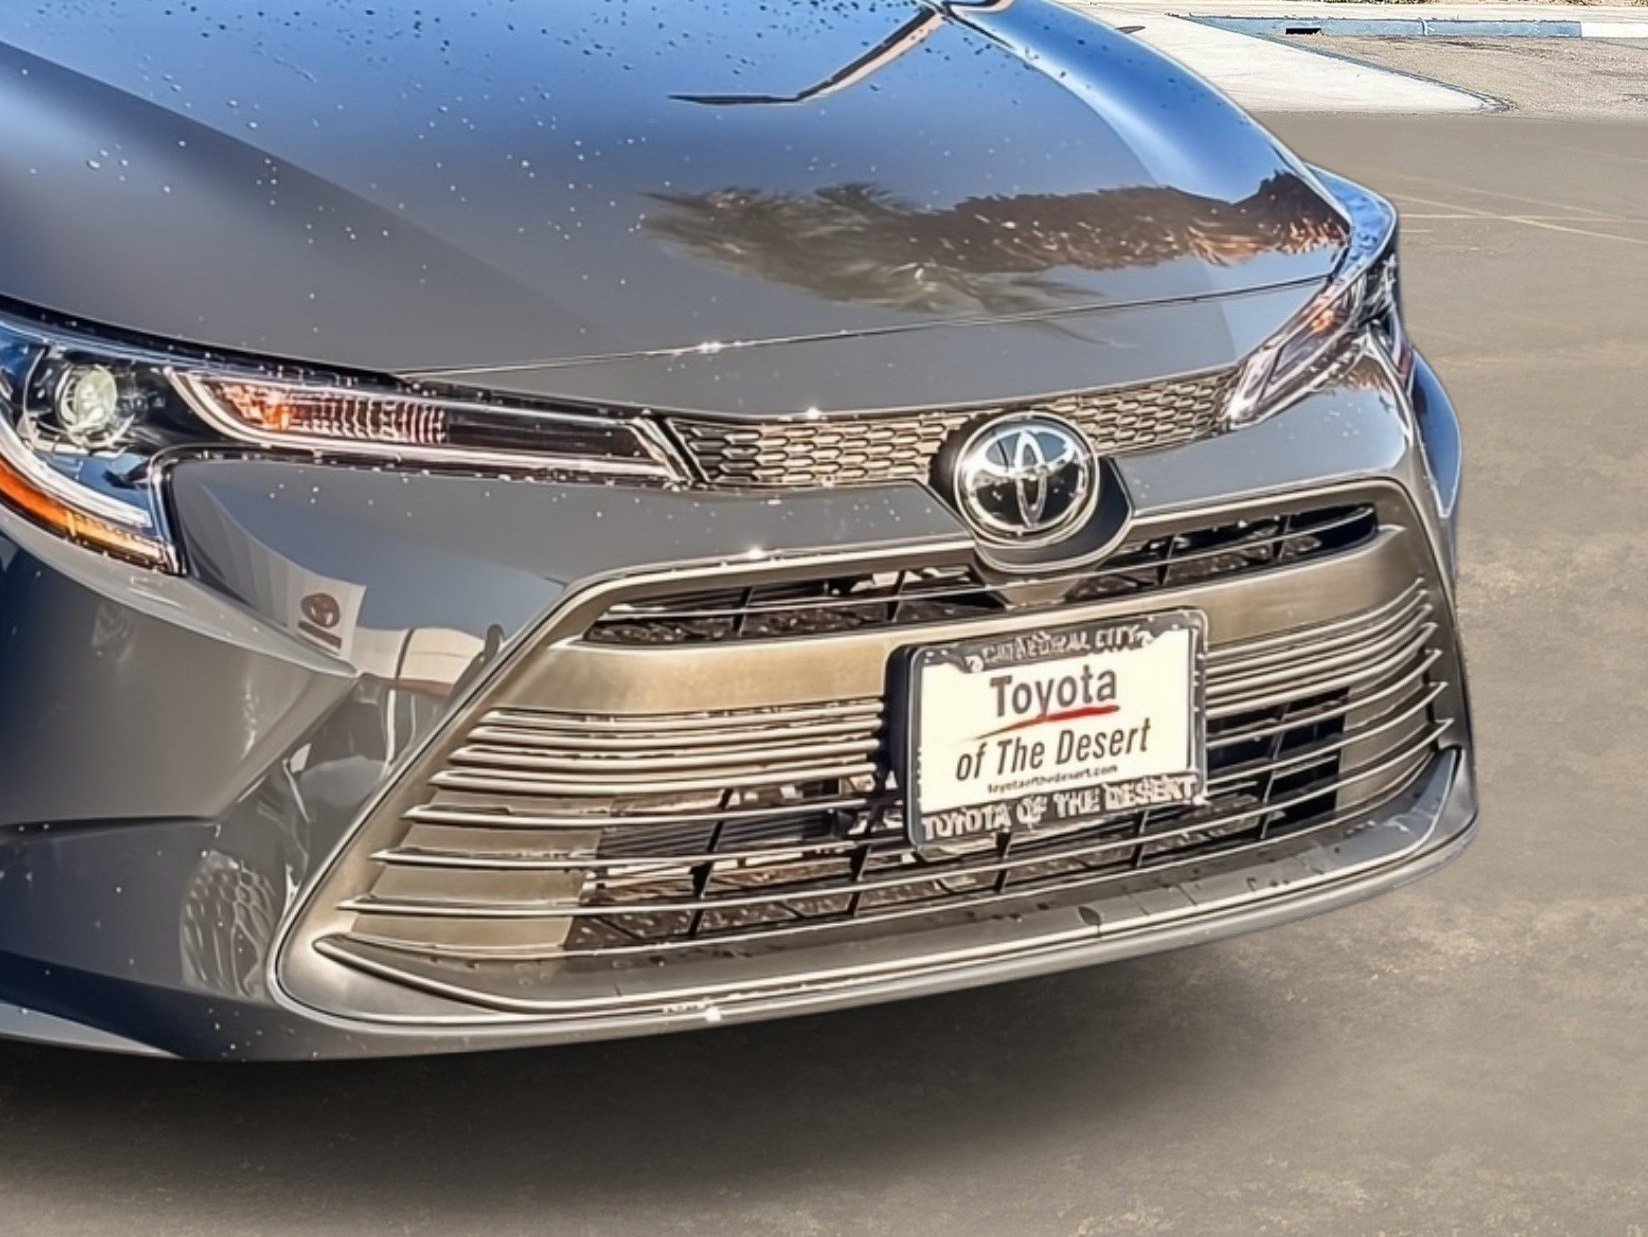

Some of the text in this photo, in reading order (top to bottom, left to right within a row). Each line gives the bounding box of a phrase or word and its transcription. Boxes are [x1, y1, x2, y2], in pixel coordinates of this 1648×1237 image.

[989, 664, 1117, 721] Toyota
[956, 717, 1151, 782] of The Desert
[921, 803, 1012, 841] TOYOTA
[1053, 788, 1103, 818] THE
[1102, 774, 1198, 810] DESERT
